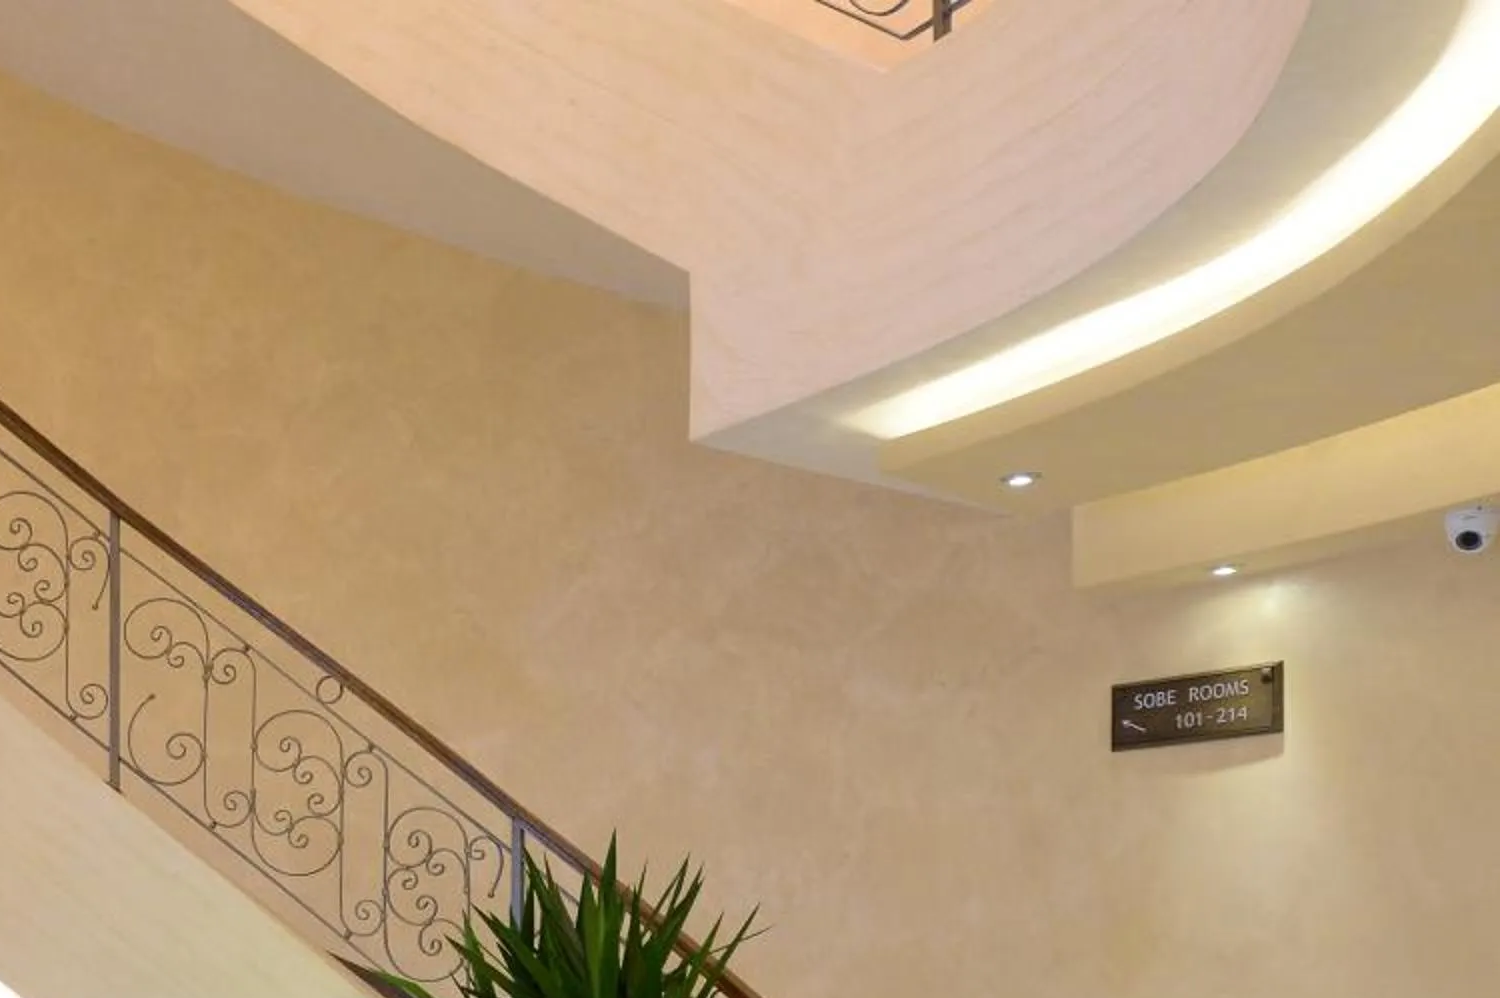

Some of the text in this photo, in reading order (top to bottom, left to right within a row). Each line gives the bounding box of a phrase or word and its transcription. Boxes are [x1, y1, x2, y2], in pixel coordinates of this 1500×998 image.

[1133, 679, 1249, 710] SOBE ROOMS
[1175, 706, 1248, 729] 101-214
